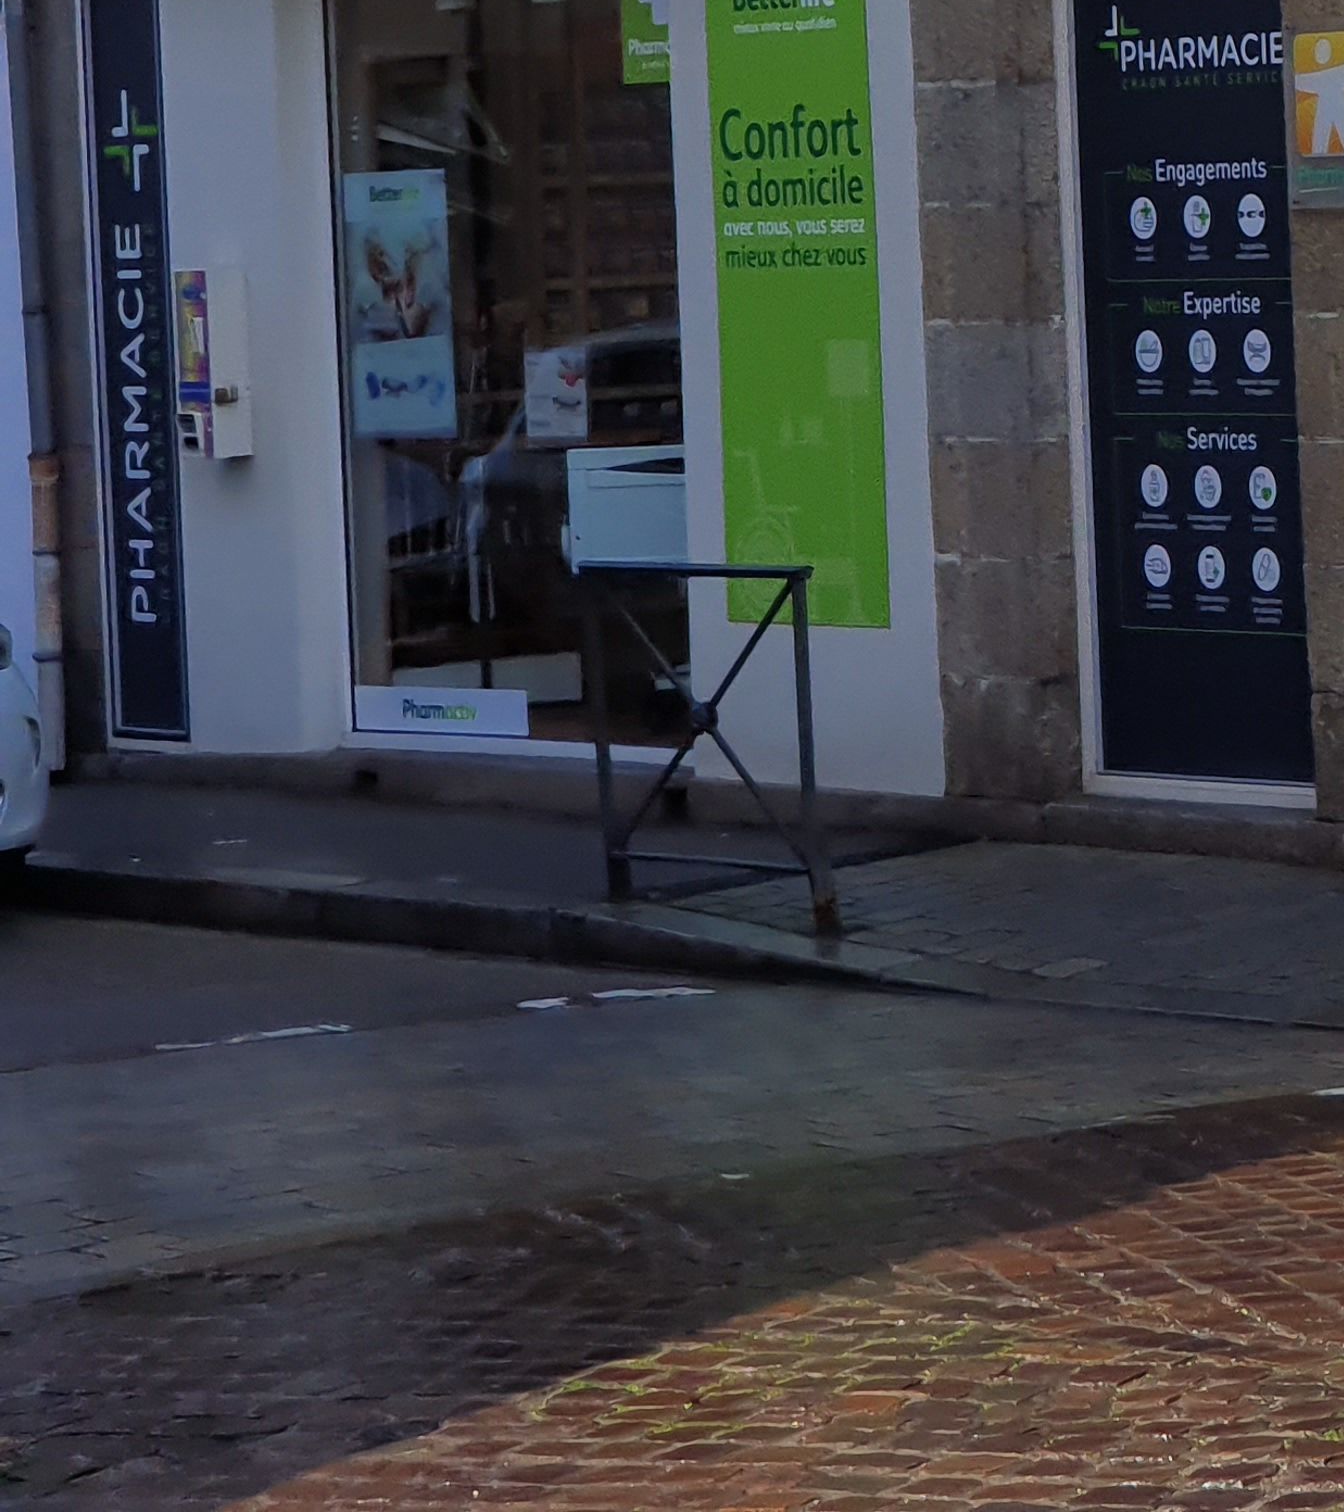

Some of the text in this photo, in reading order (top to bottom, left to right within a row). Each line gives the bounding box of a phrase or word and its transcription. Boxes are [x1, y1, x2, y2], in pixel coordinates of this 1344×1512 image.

[1120, 32, 1284, 74] PHARMACIE
[1228, 70, 1284, 85] SERVIC
[719, 104, 862, 162] Confort
[1155, 158, 1267, 186] Engagements
[722, 165, 864, 209] à domicile
[724, 221, 754, 237] avec
[796, 218, 826, 235] vous
[831, 218, 865, 235] serez
[726, 243, 866, 269] mieux chez vous
[1183, 290, 1261, 319] Expertise
[114, 223, 157, 623] PHARMACIE
[1186, 427, 1257, 451] Services
